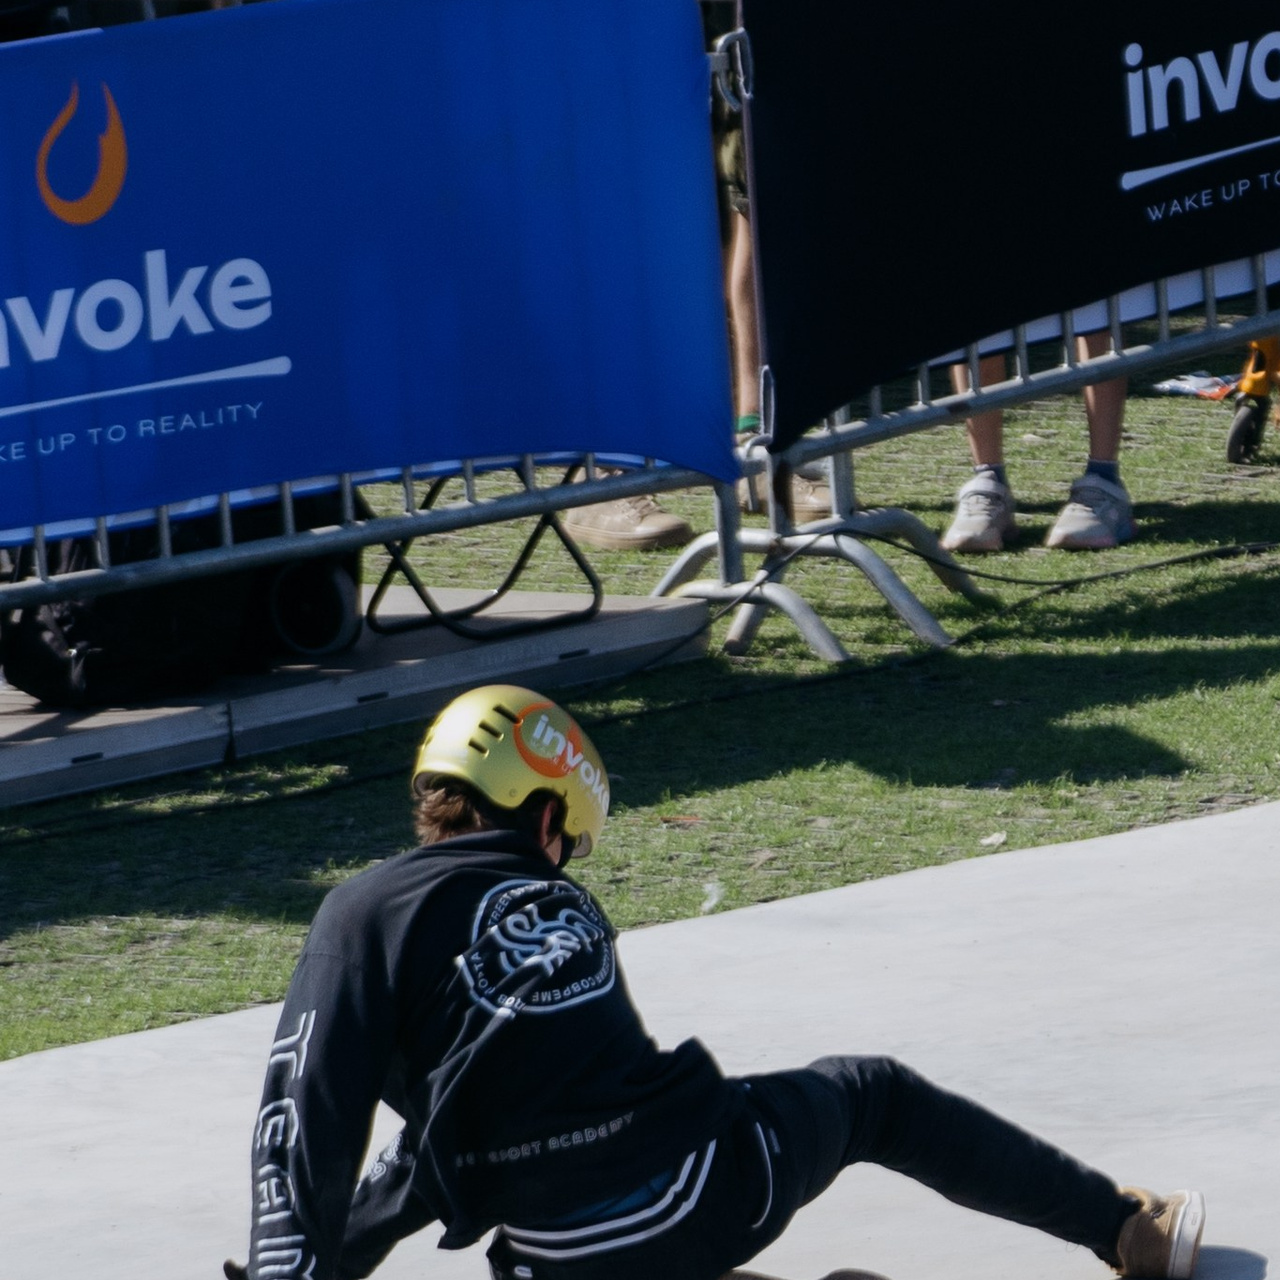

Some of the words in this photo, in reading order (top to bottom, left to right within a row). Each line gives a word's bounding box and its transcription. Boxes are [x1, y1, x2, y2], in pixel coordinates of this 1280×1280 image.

[1147, 188, 1214, 222] WAKE
[1221, 179, 1250, 202] UP
[38, 432, 76, 455] UP
[88, 424, 128, 445] TO
[138, 401, 263, 437] REALITY
